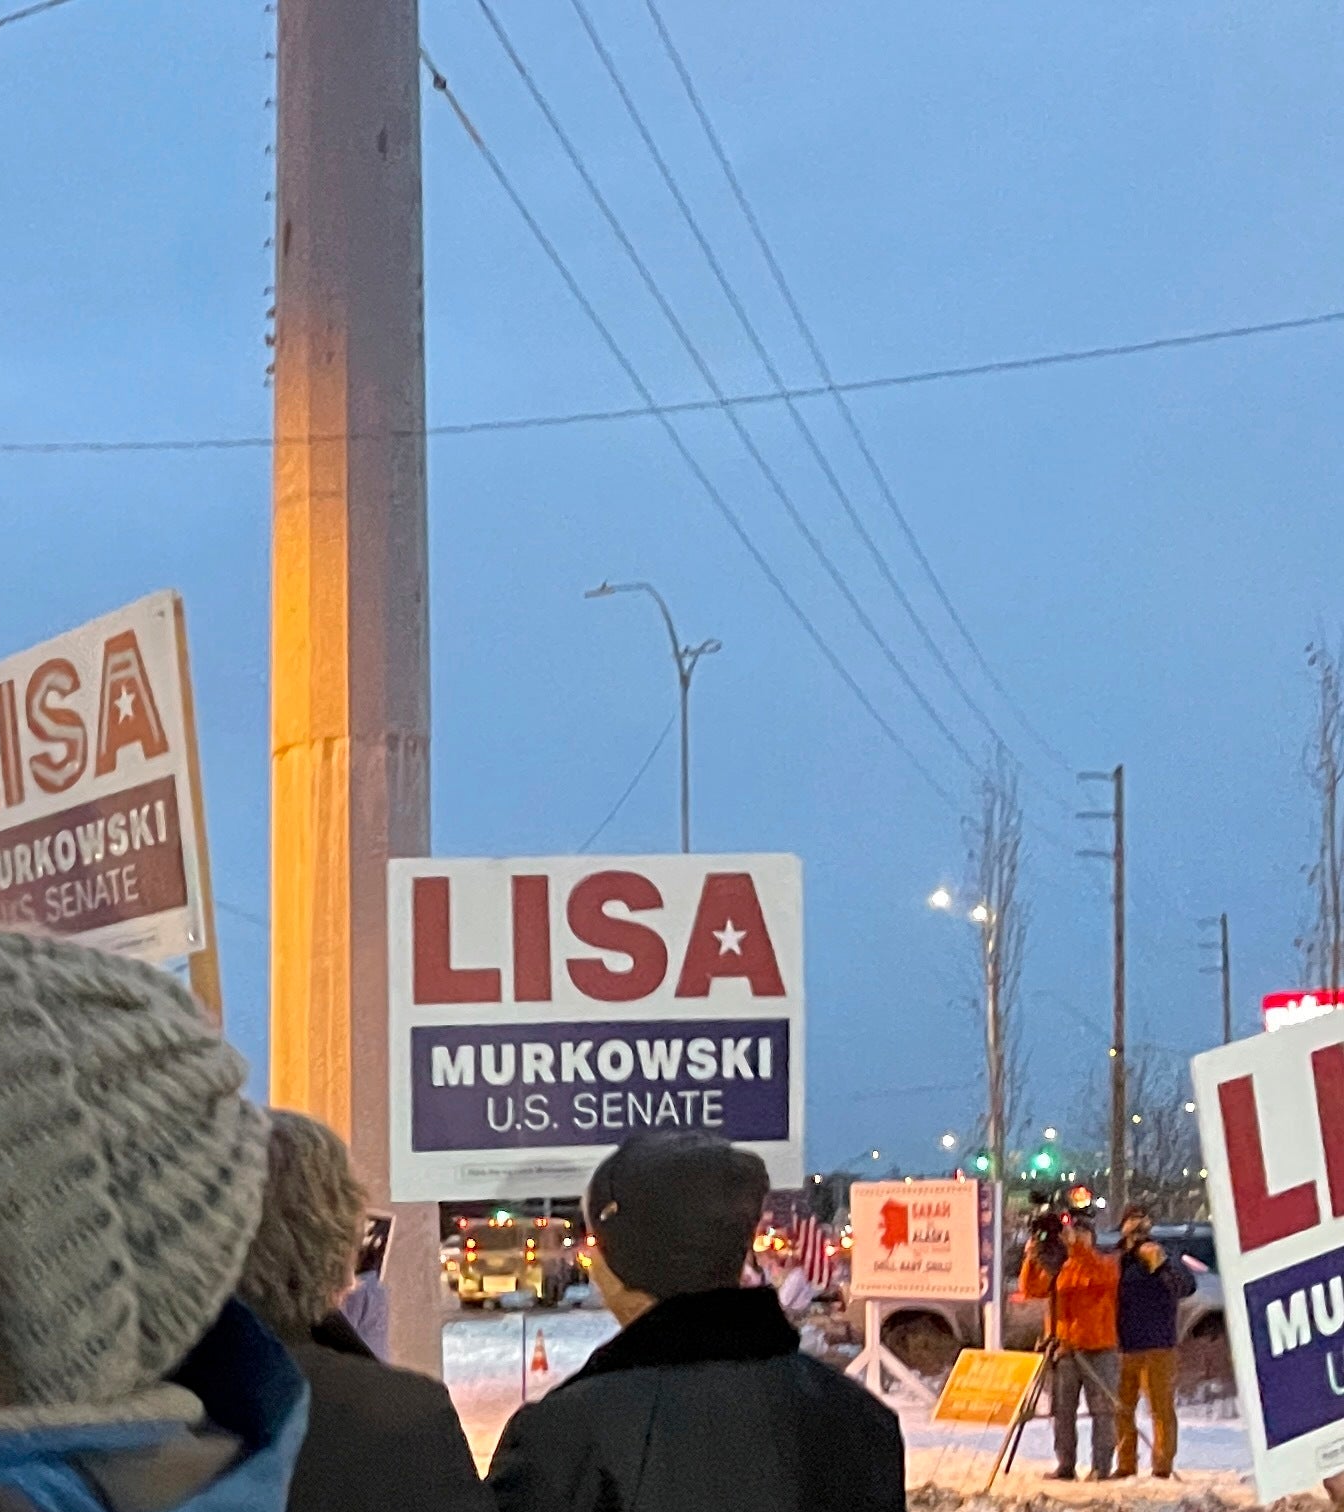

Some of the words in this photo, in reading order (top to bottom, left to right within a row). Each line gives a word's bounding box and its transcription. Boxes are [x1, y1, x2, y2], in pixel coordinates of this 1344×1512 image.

[44, 863, 140, 923] SENATE
[412, 869, 787, 1005] LISA
[430, 1036, 773, 1088] MURKOWSKI
[486, 1092, 559, 1132] U.S.
[572, 1088, 724, 1130] SENATE
[1218, 1042, 1344, 1252] LI
